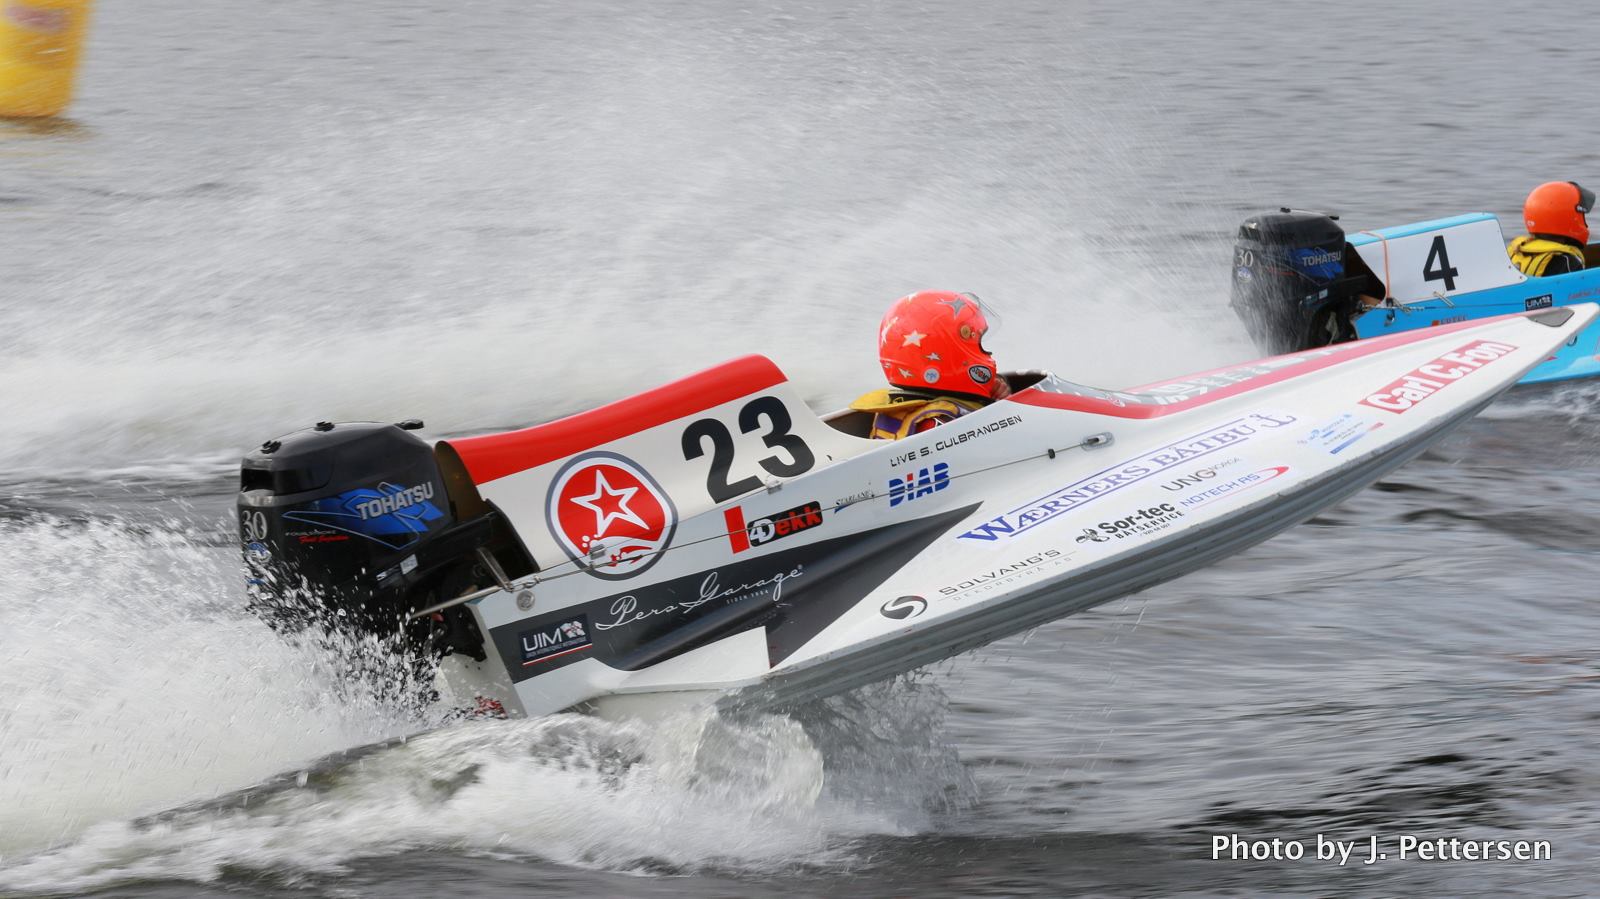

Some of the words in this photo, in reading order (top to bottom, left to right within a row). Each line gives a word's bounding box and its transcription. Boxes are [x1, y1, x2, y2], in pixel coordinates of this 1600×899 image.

[1302, 251, 1342, 267] TOHATSU
[1423, 235, 1459, 291] 4
[1366, 376, 1445, 409] Carl
[1446, 342, 1517, 368] Fon
[681, 395, 815, 504] 23
[890, 451, 917, 467] LIVE
[920, 446, 934, 457] S.
[936, 415, 1023, 451] GULBRANDSEN
[356, 481, 434, 521] TOHATSU
[956, 465, 1151, 543] WÆRNERS
[1179, 481, 1239, 507] NOTECH
[242, 510, 267, 541] 30
[750, 504, 821, 543] 4Dekk
[1098, 501, 1176, 534] Sor-tec
[939, 549, 1061, 595] SOLVANG'S
[595, 595, 679, 630] Pers
[679, 568, 804, 614] Garage
[522, 627, 562, 652] UIM
